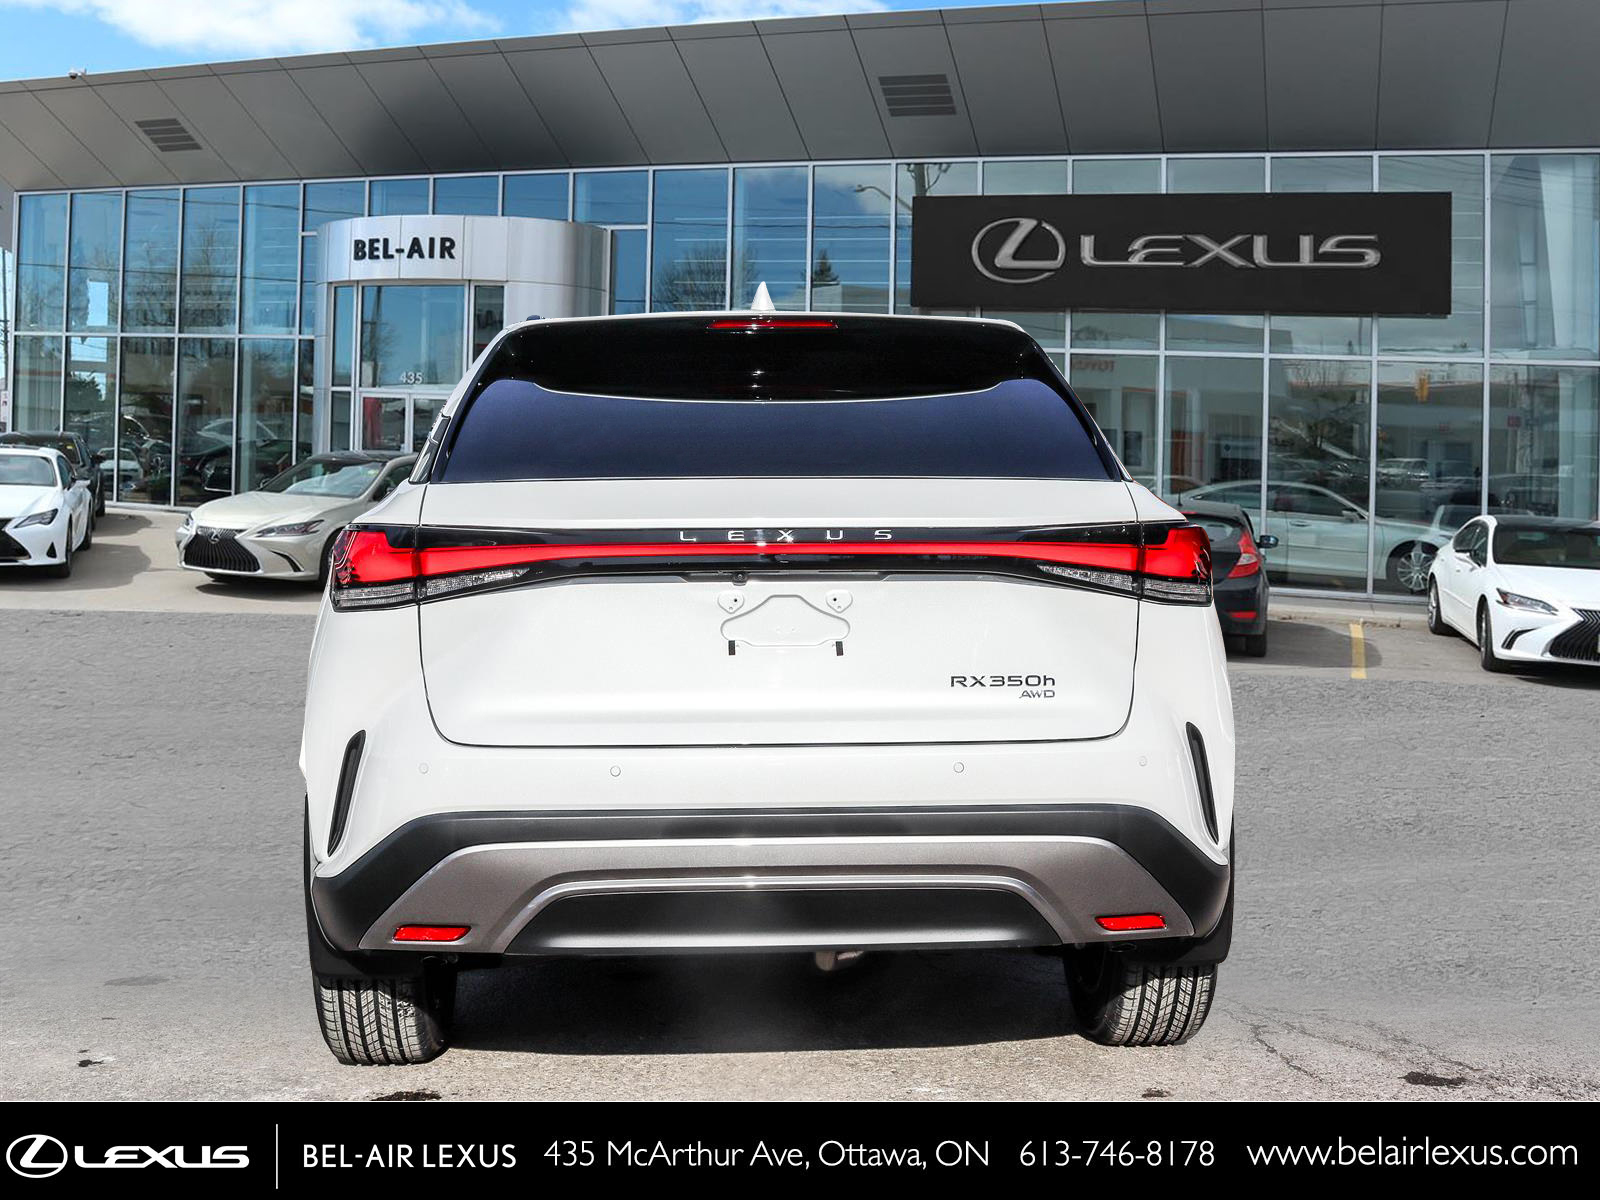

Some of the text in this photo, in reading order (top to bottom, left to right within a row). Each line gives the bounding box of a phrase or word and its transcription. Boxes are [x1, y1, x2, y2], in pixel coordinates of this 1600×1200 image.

[353, 236, 457, 261] BEL-AIR
[1080, 233, 1382, 269] LEXUS
[399, 371, 424, 385] 435
[678, 528, 894, 543] LEXUS
[950, 674, 1056, 688] RX350h
[1019, 689, 1056, 699] AWD
